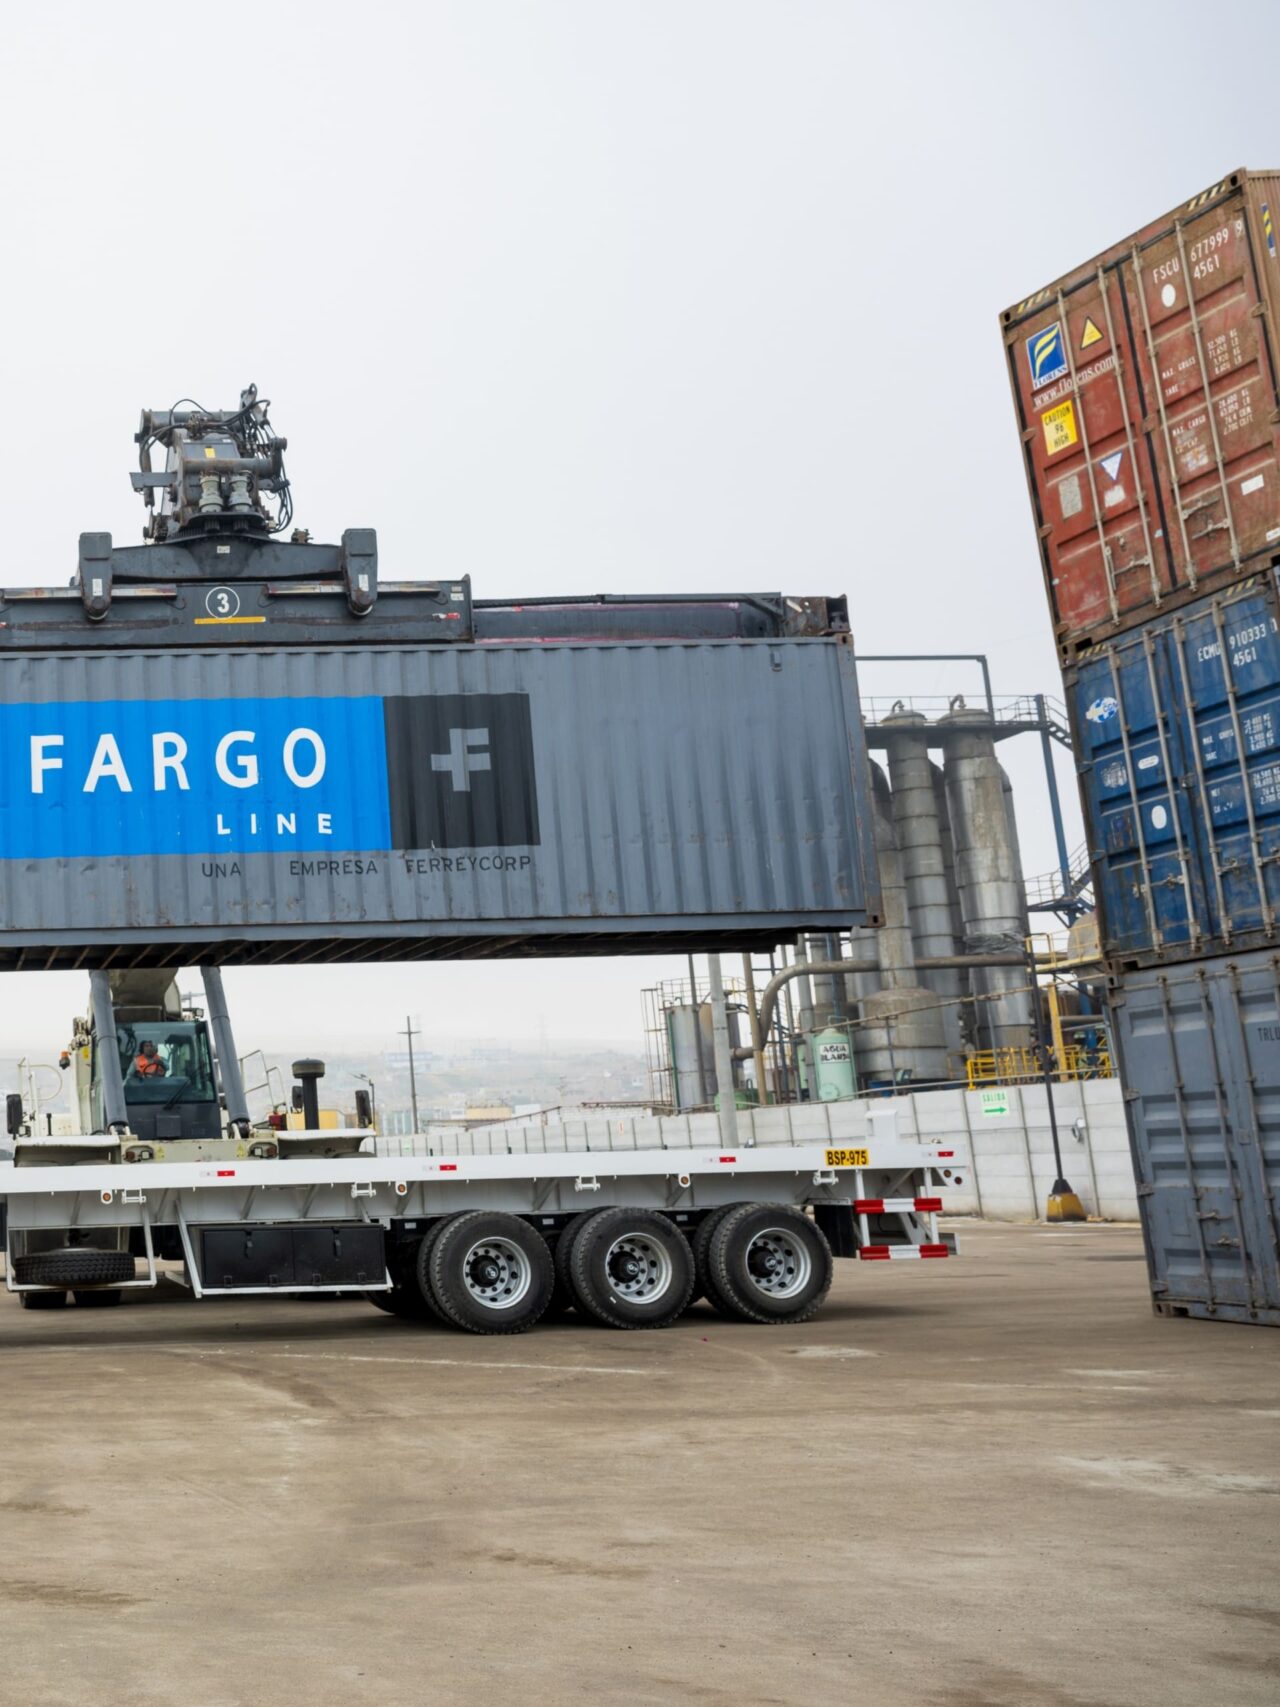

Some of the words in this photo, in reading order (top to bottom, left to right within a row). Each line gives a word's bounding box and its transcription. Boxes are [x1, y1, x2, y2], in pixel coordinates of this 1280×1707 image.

[1152, 257, 1180, 284] FSCU
[1190, 228, 1229, 262] 677999
[1193, 254, 1220, 279] 45G1
[1033, 367, 1068, 388] FLORENS
[1034, 356, 1116, 407] www.floens.com
[1044, 405, 1070, 426] CAUTION
[1054, 432, 1070, 449] HIGH
[217, 593, 230, 613] 3
[1228, 623, 1266, 650] 910333
[1232, 646, 1257, 667] 45G1
[29, 727, 327, 794] FARGO
[217, 812, 333, 835] LINE
[201, 860, 242, 878] UNA
[290, 858, 379, 877] EMPRESA
[406, 854, 531, 875] FERREYCORP
[1257, 1026, 1280, 1042] TRLU
[823, 1045, 847, 1053] AGUA
[982, 1092, 1006, 1102] SALIDA
[827, 1150, 867, 1166] BSP-975
